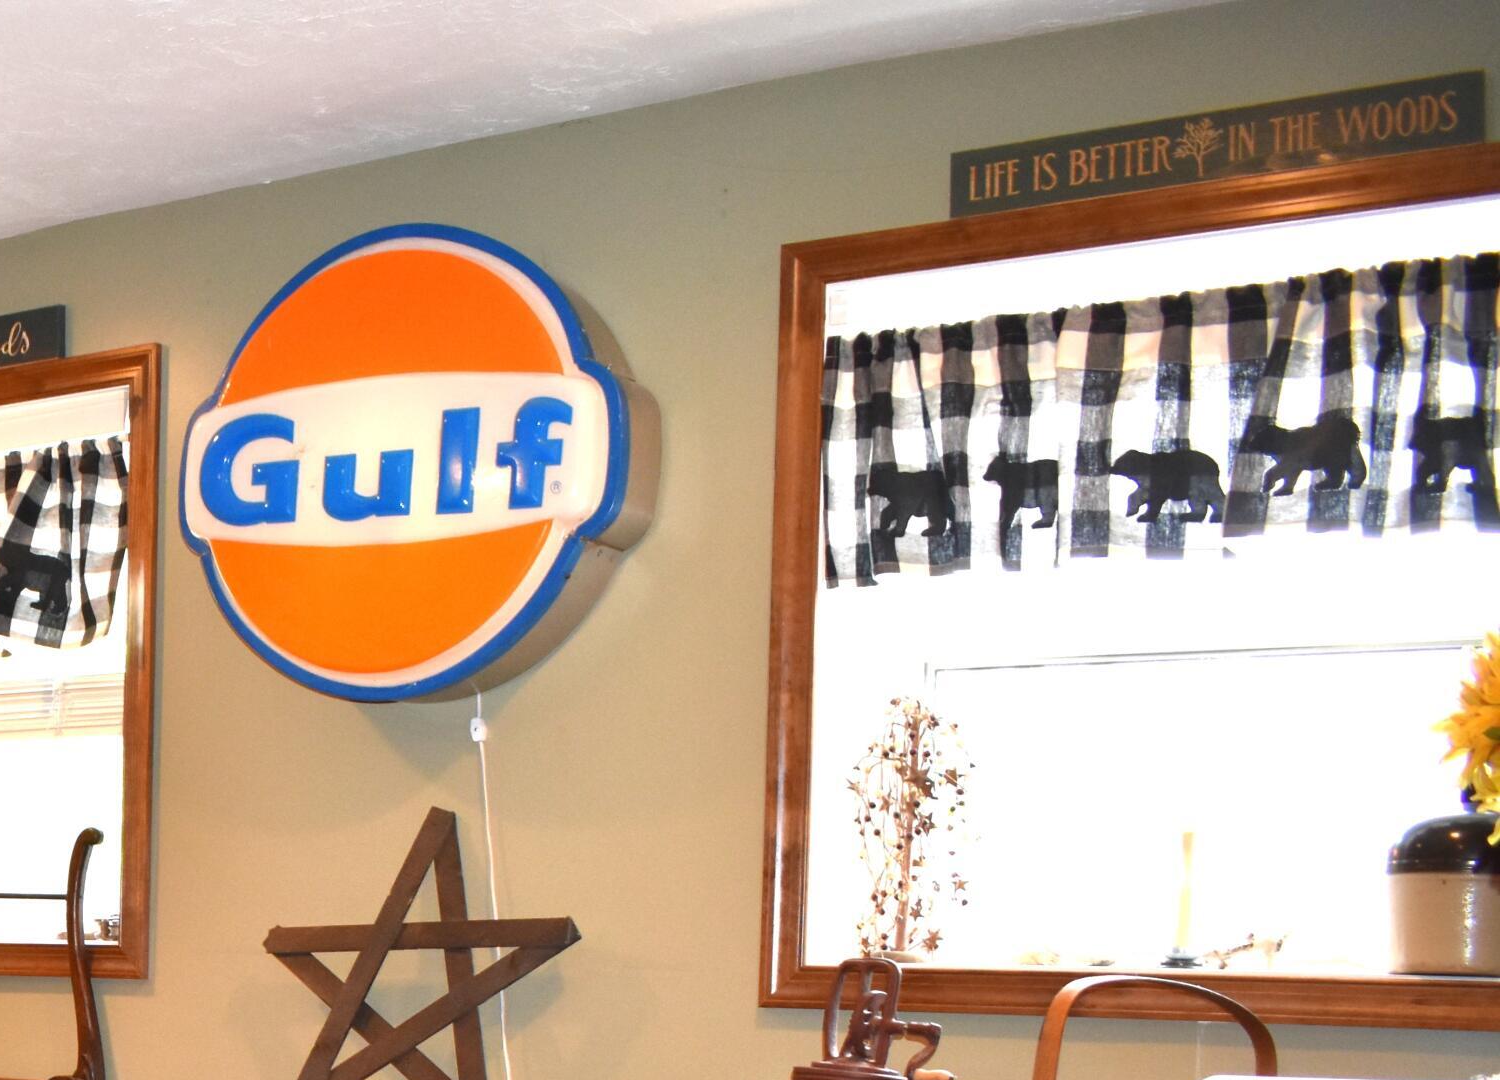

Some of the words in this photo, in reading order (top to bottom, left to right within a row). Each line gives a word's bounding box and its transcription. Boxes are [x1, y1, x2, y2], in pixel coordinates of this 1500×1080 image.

[969, 158, 1020, 202] LIFE
[1032, 151, 1059, 192] IS
[1069, 135, 1173, 187] BETTER
[1228, 120, 1257, 162] IN
[1269, 110, 1322, 152] THE
[1337, 90, 1459, 145] WOODS
[200, 396, 574, 528] Gulf
